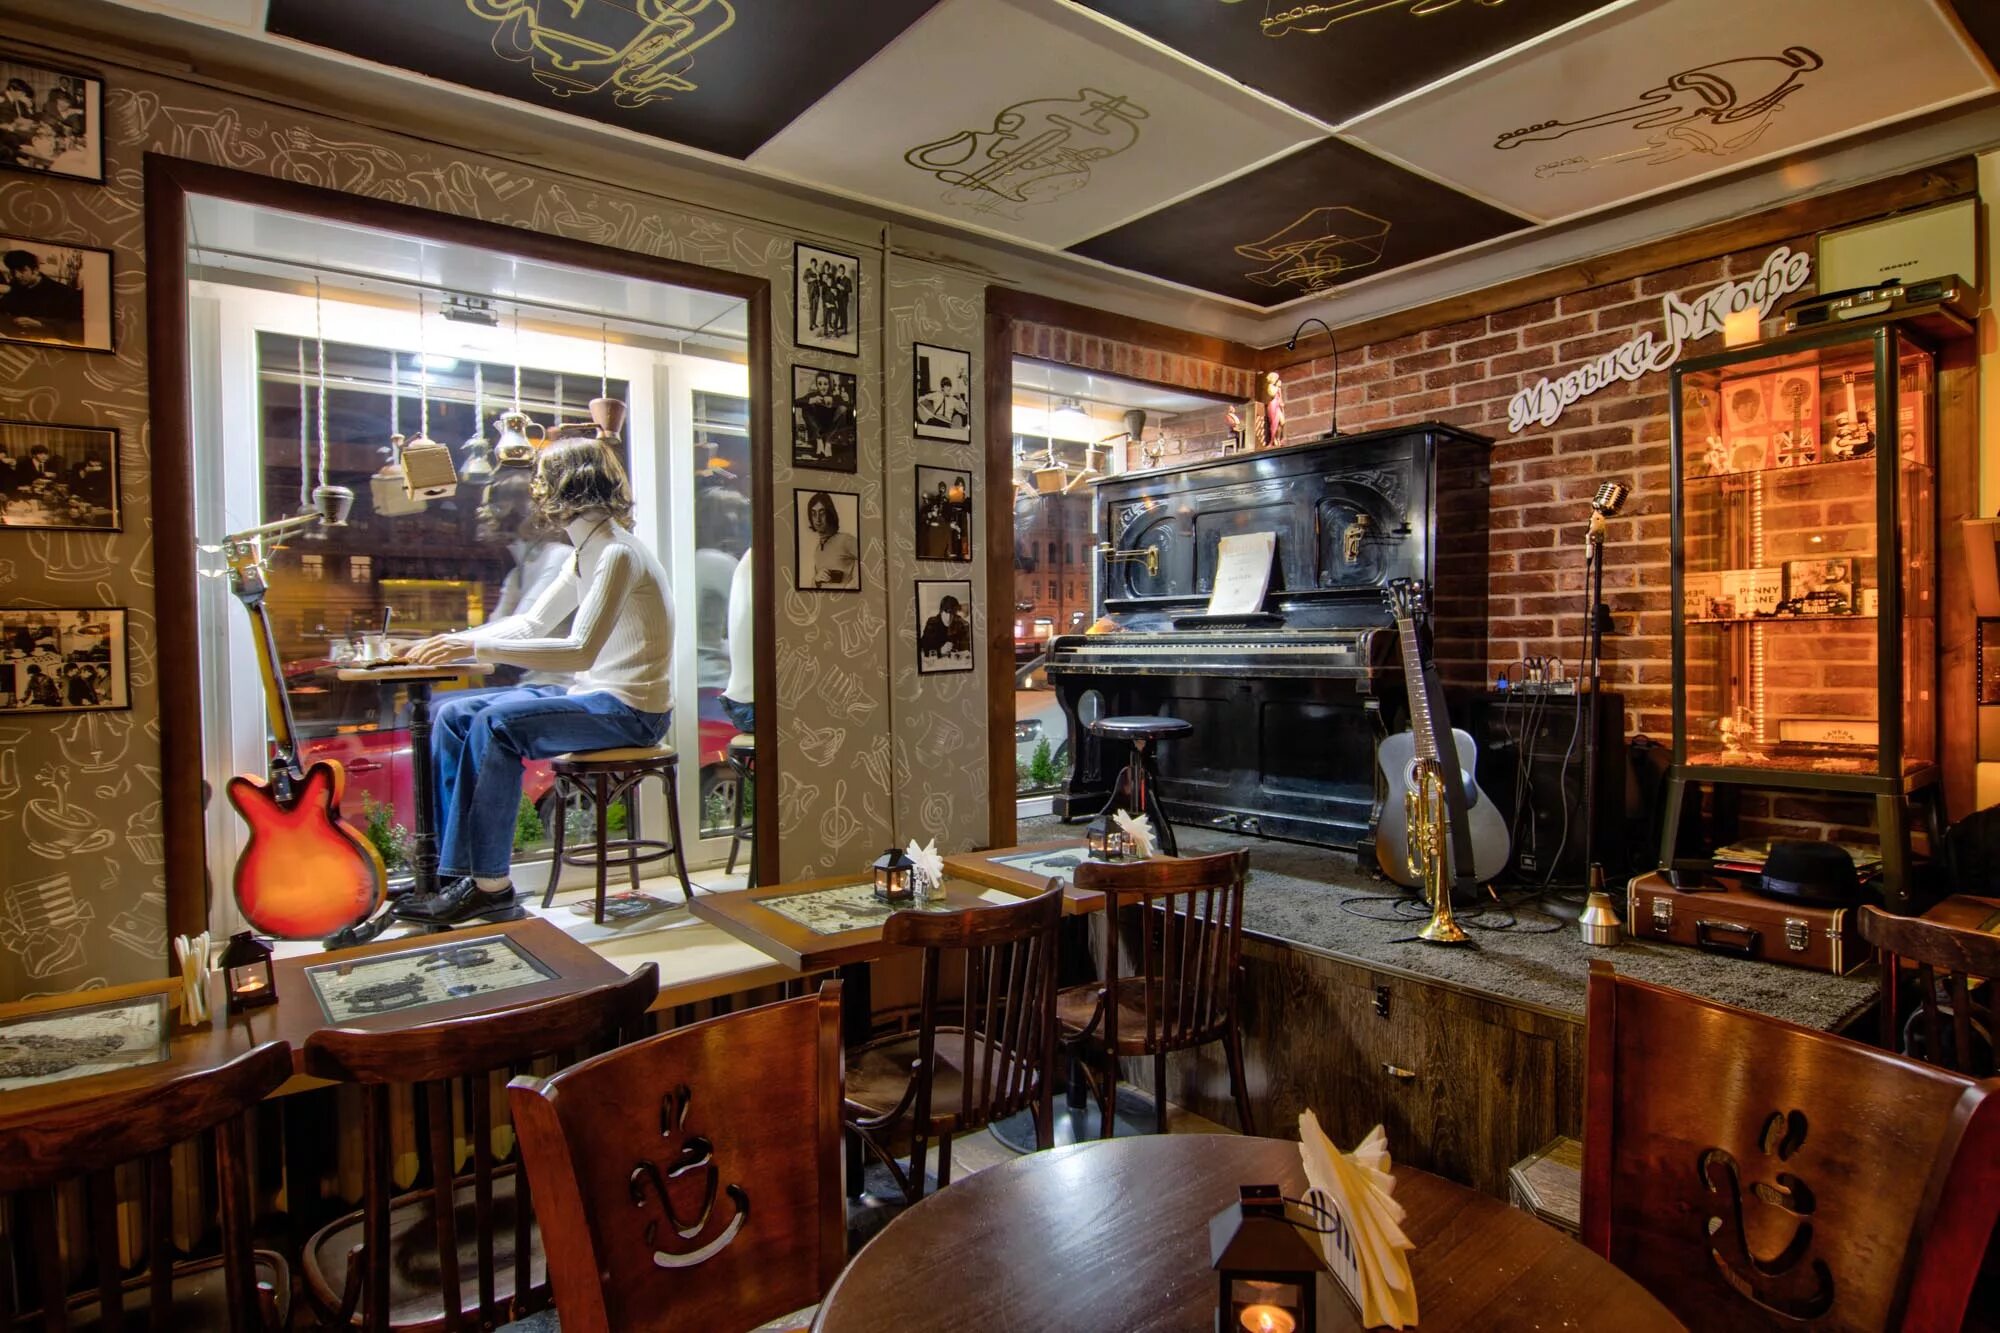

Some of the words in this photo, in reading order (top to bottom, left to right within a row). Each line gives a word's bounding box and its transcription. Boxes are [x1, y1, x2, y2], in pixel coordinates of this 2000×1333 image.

[1510, 334, 1652, 428] Музыка
[1692, 250, 1808, 330] Кофе
[1740, 586, 1779, 595] PENNY
